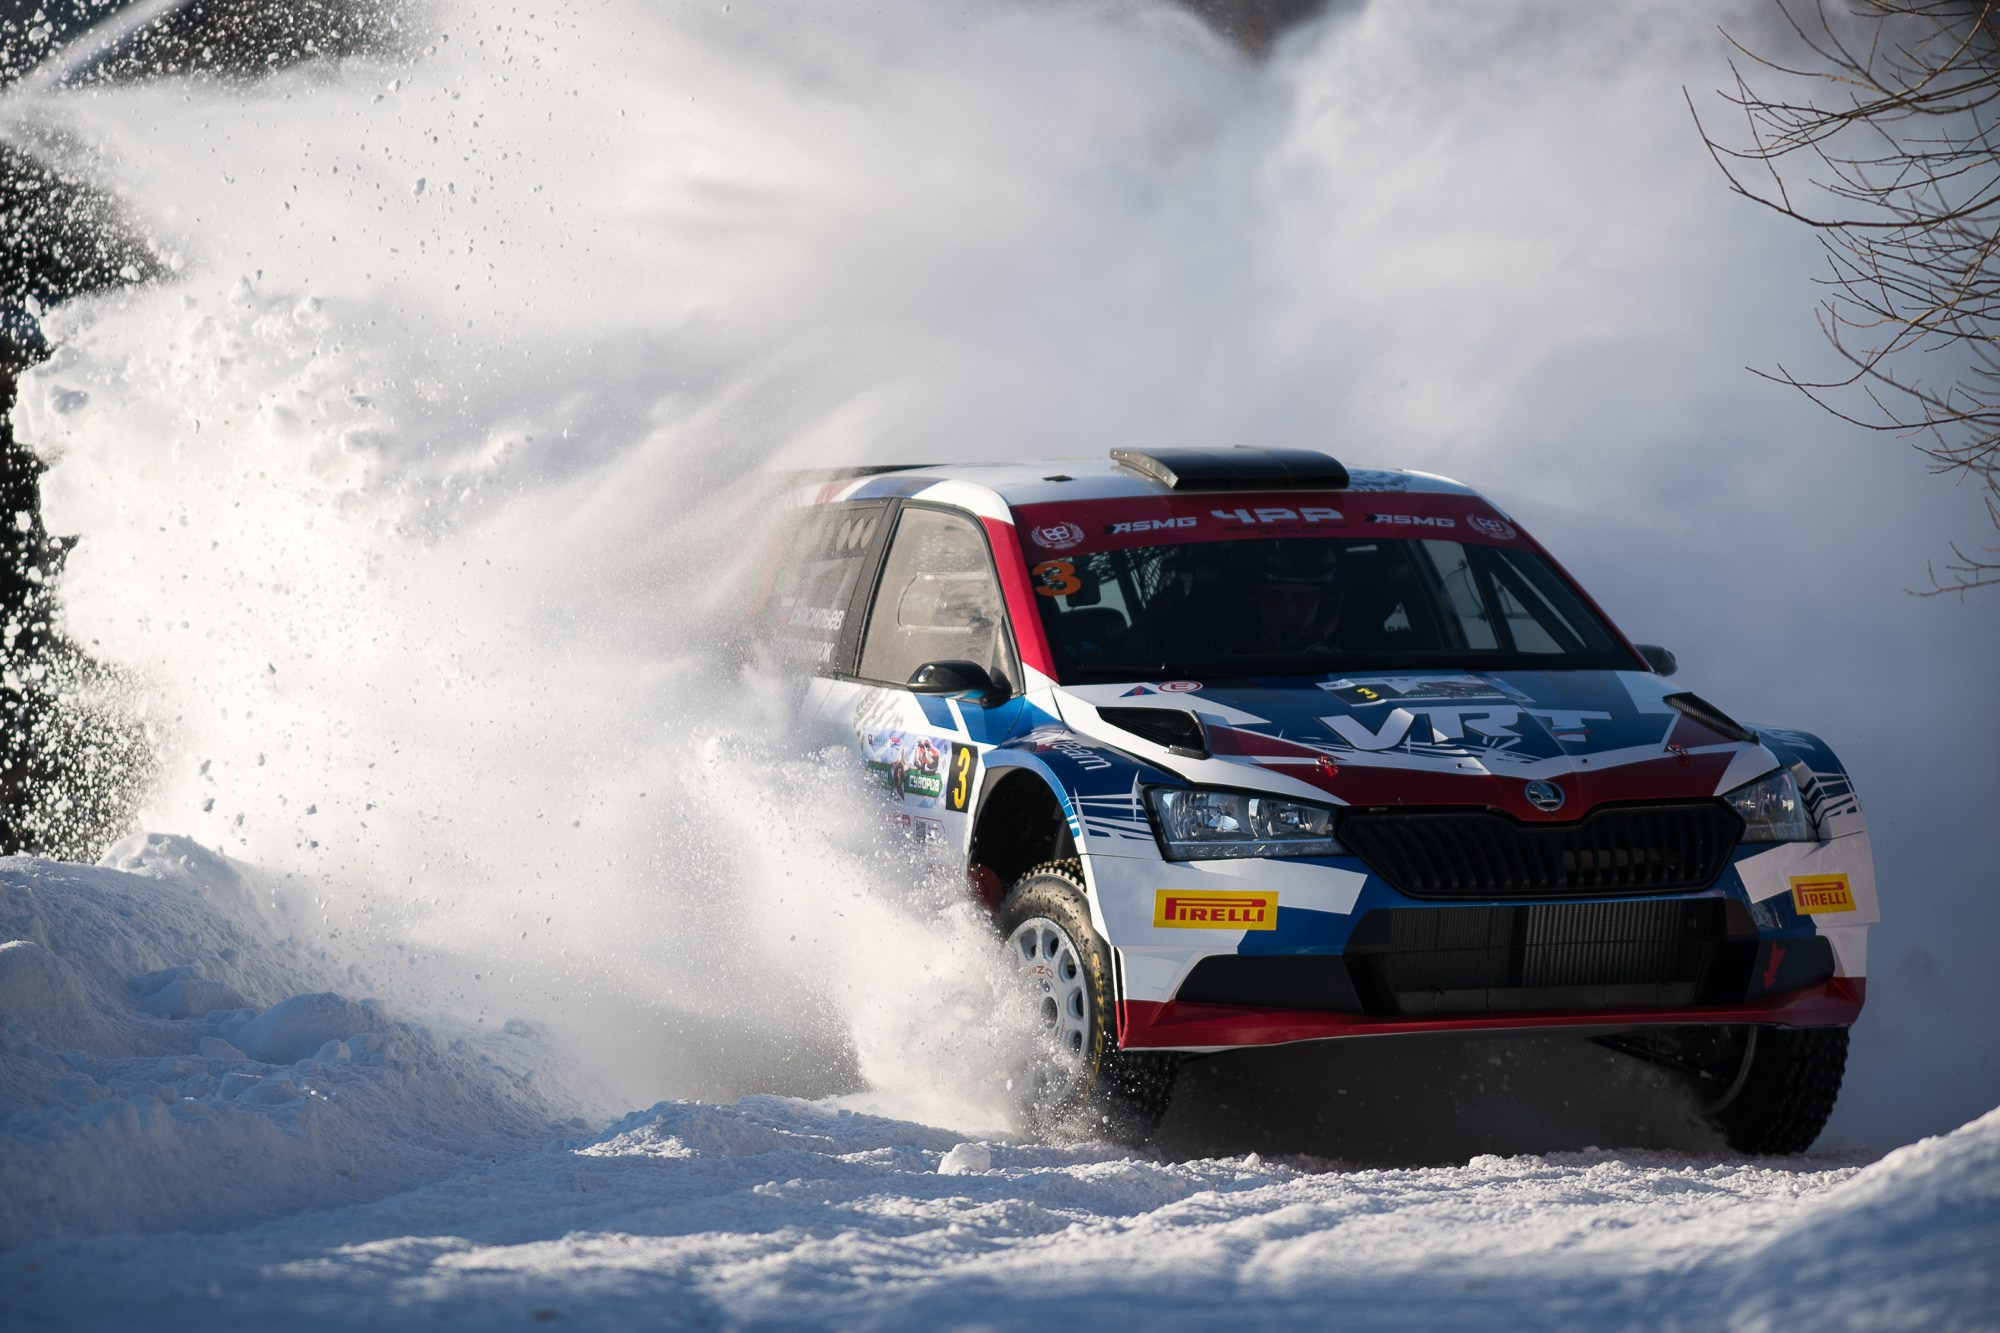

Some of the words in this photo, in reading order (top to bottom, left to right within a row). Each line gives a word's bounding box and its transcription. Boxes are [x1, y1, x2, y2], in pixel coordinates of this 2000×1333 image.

[1112, 516, 1197, 535] ASMG
[1374, 513, 1455, 528] ASMG
[1032, 561, 1081, 597] 3
[1357, 687, 1378, 699] 3
[909, 775, 940, 792] СУВОРОВ
[953, 747, 971, 809] 3
[1795, 881, 1848, 907] PIRELLI
[1165, 897, 1267, 922] PIRELLI
